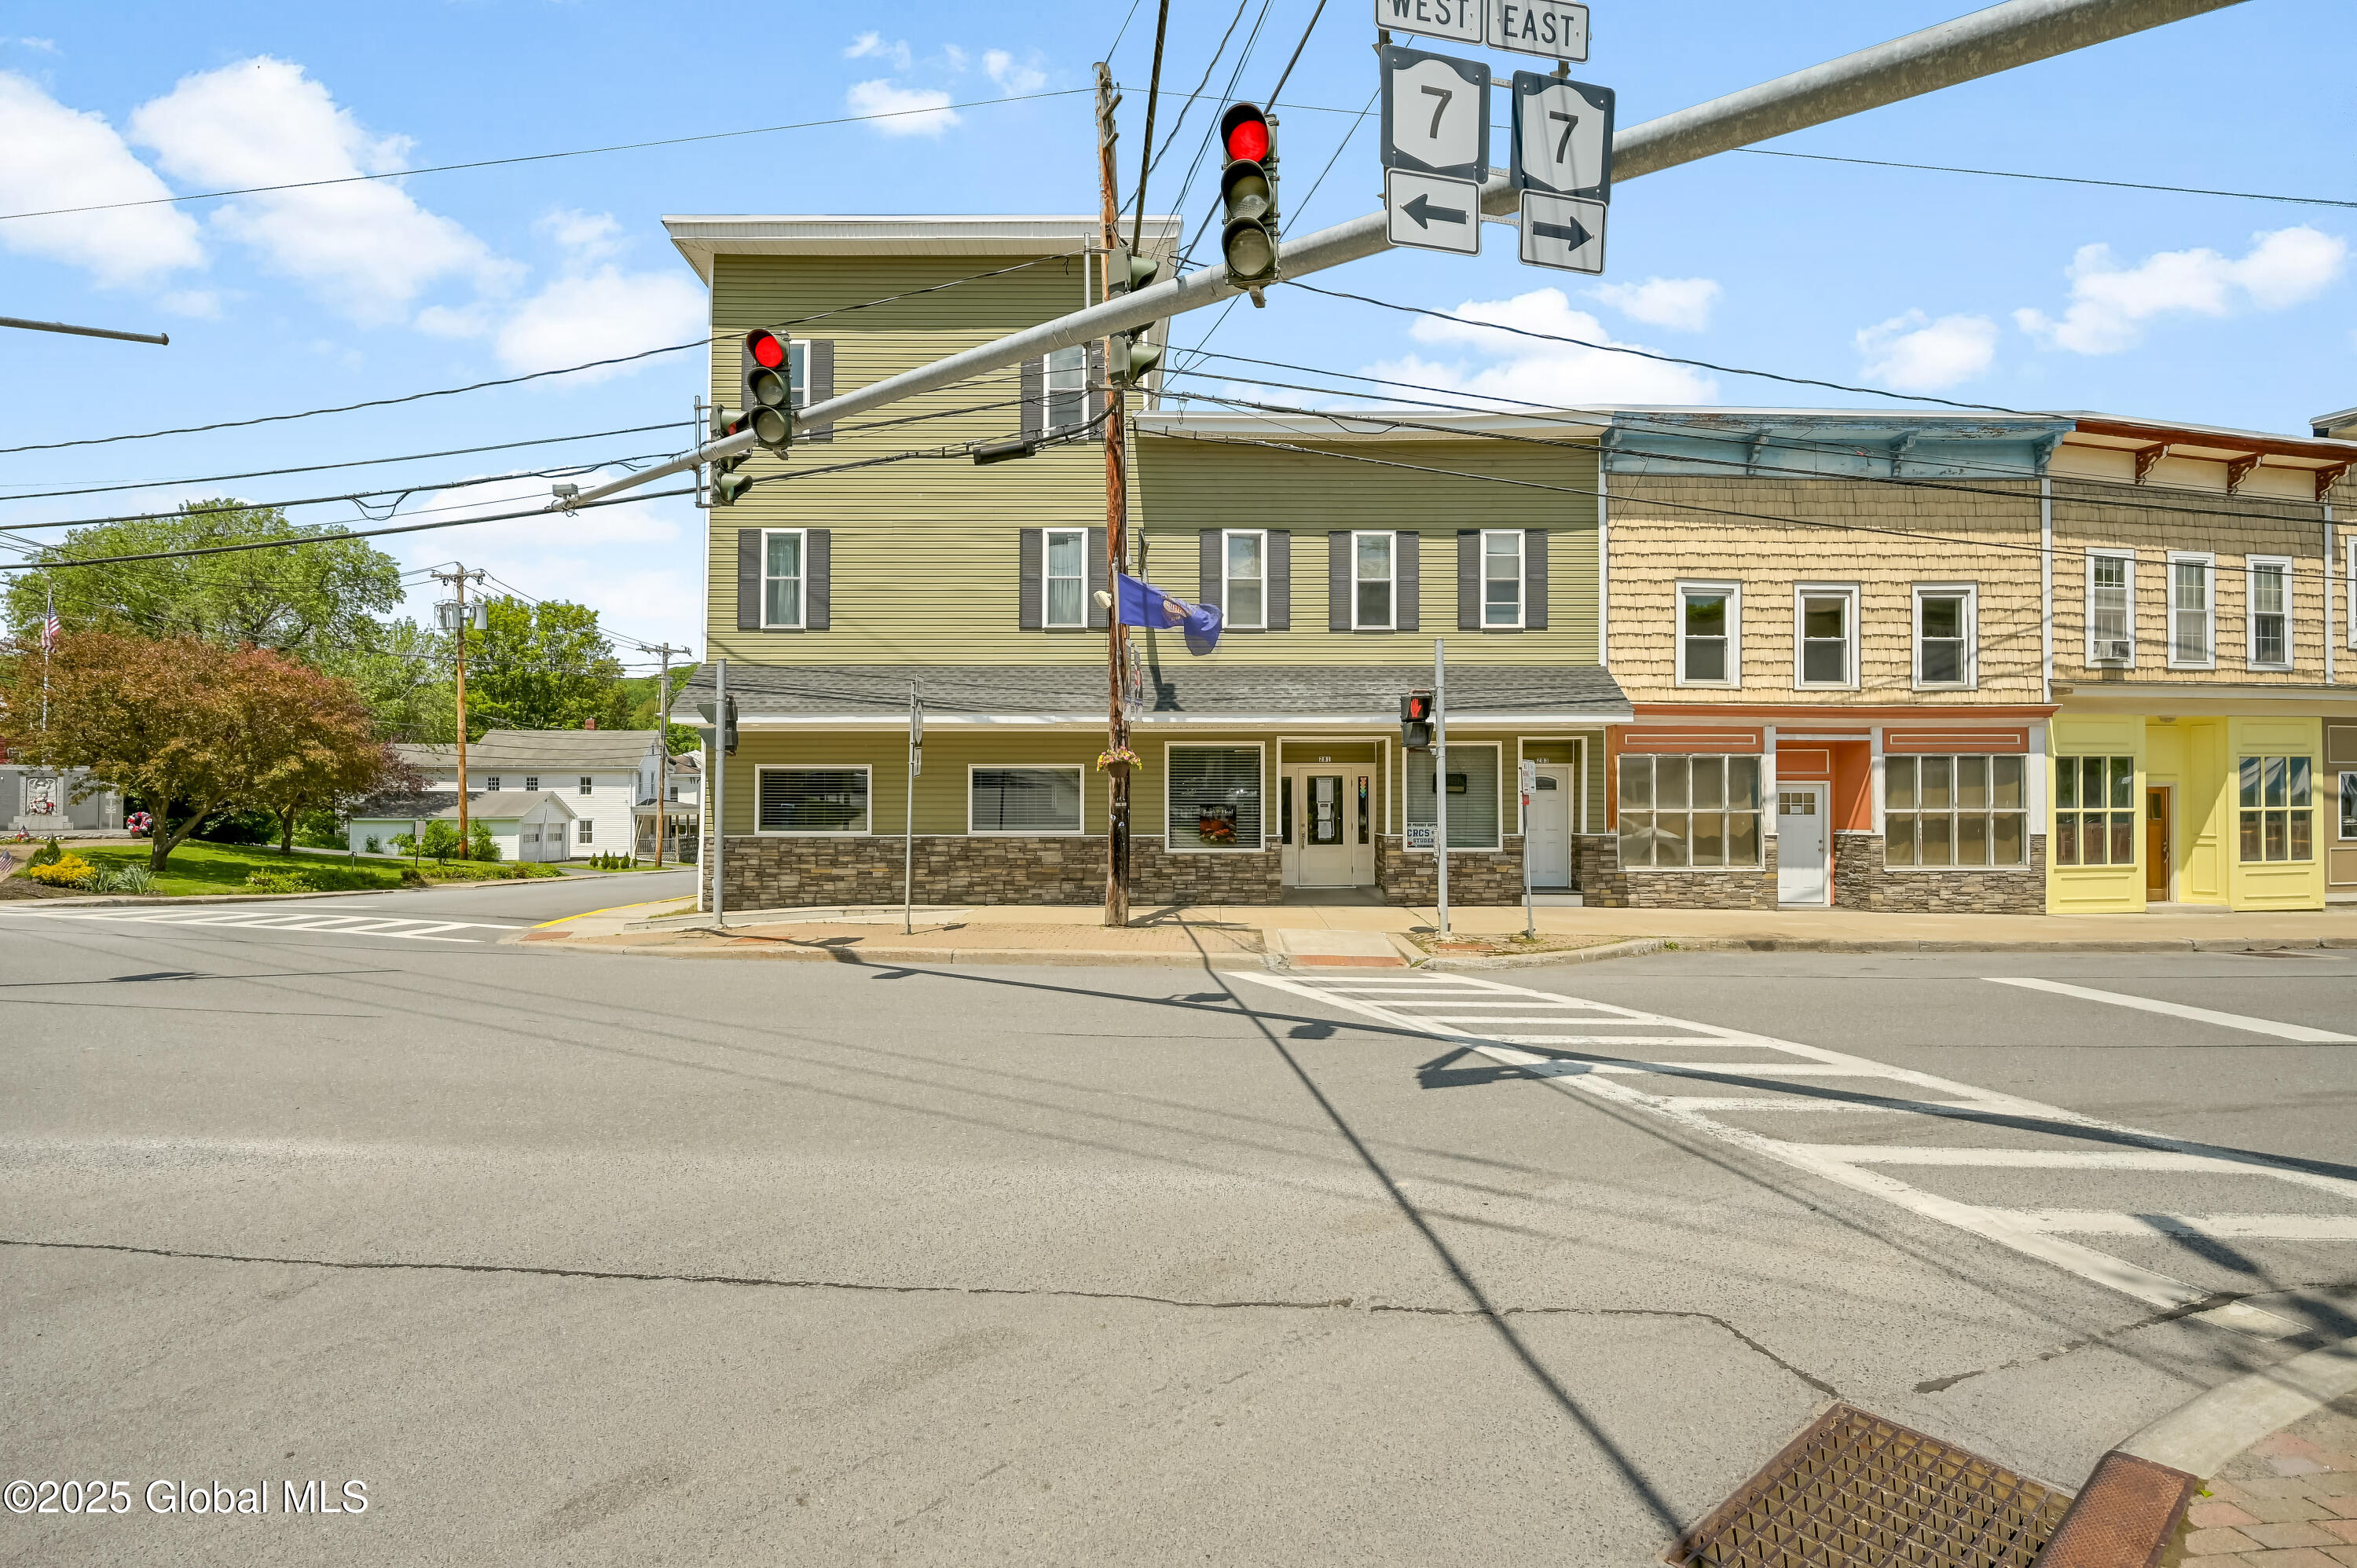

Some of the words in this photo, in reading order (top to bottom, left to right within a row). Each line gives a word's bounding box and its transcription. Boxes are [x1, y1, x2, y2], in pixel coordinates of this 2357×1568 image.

[1392, 0, 1469, 27] WEST
[1505, 5, 1574, 46] EAST
[1420, 85, 1453, 139] 7
[1549, 110, 1578, 164] 7
[917, 710, 922, 735] 7
